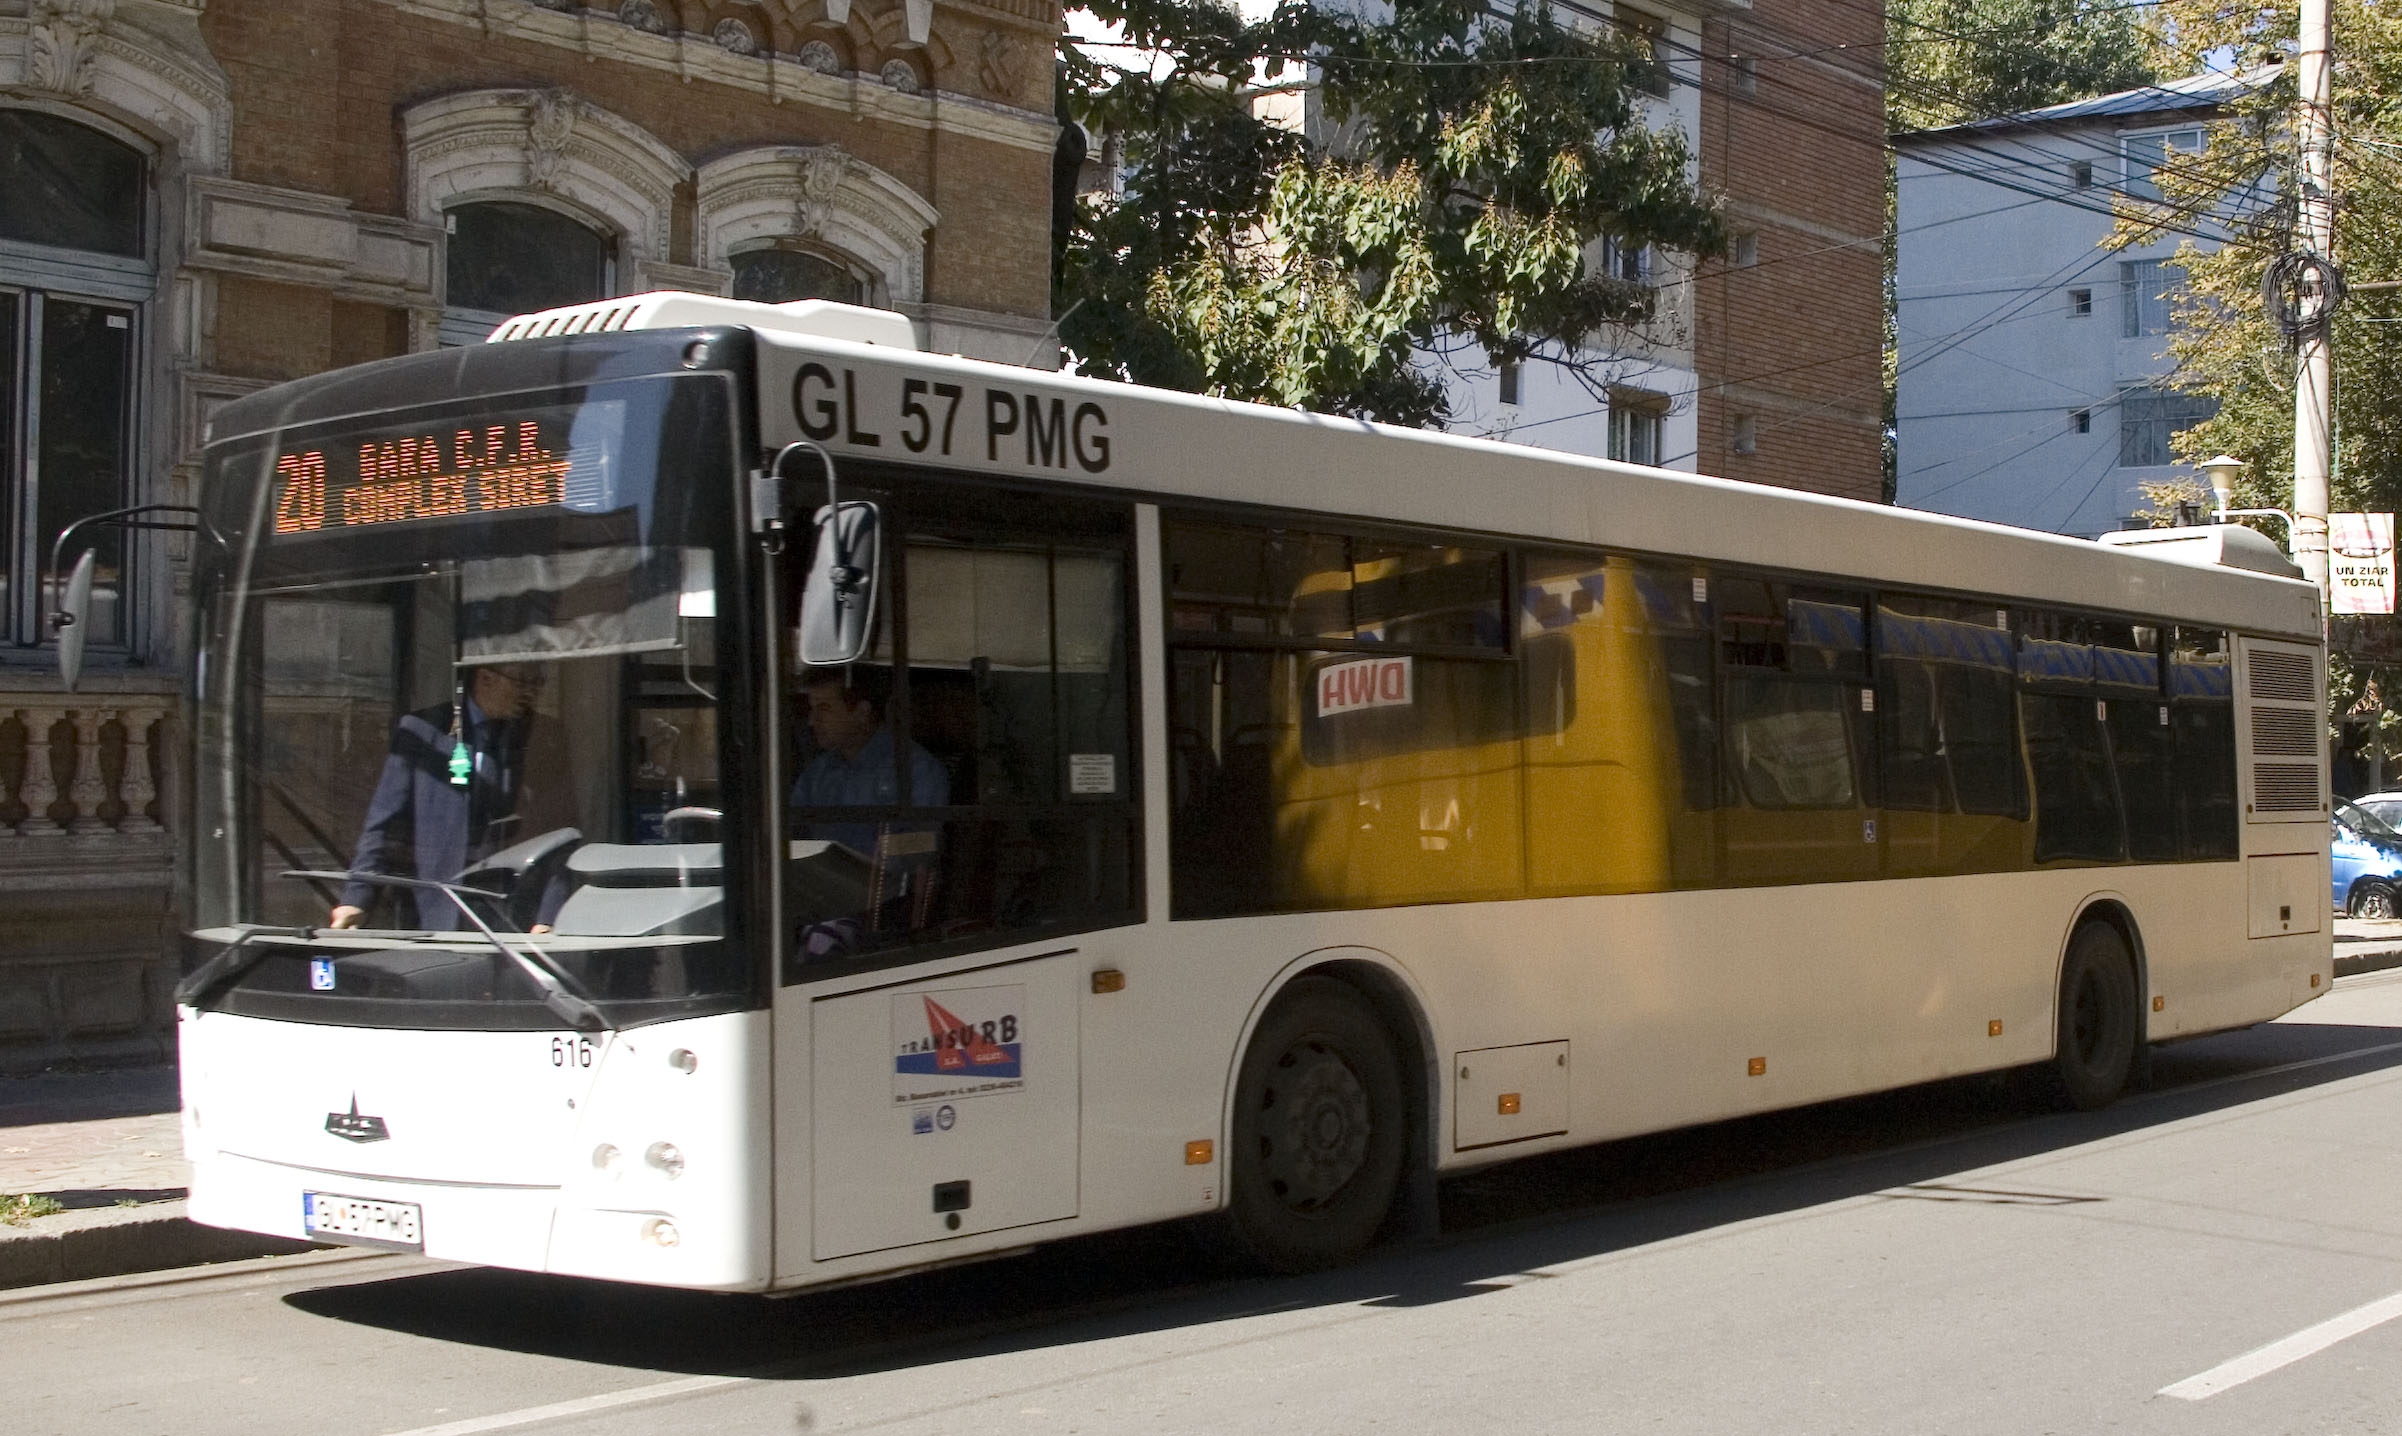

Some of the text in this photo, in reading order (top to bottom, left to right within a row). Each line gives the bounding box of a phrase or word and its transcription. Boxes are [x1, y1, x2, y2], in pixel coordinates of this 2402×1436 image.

[791, 362, 1111, 473] GL 57 PMG
[360, 435, 439, 481] GARA
[277, 451, 325, 533] 20
[344, 461, 572, 525] COMPLEX SIRET
[2336, 566, 2389, 576] UN ZIAR
[2341, 578, 2384, 587] TOTAL
[552, 1036, 592, 1068] 616
[901, 1014, 1018, 1053] TRANSURB
[319, 1200, 342, 1230] GL
